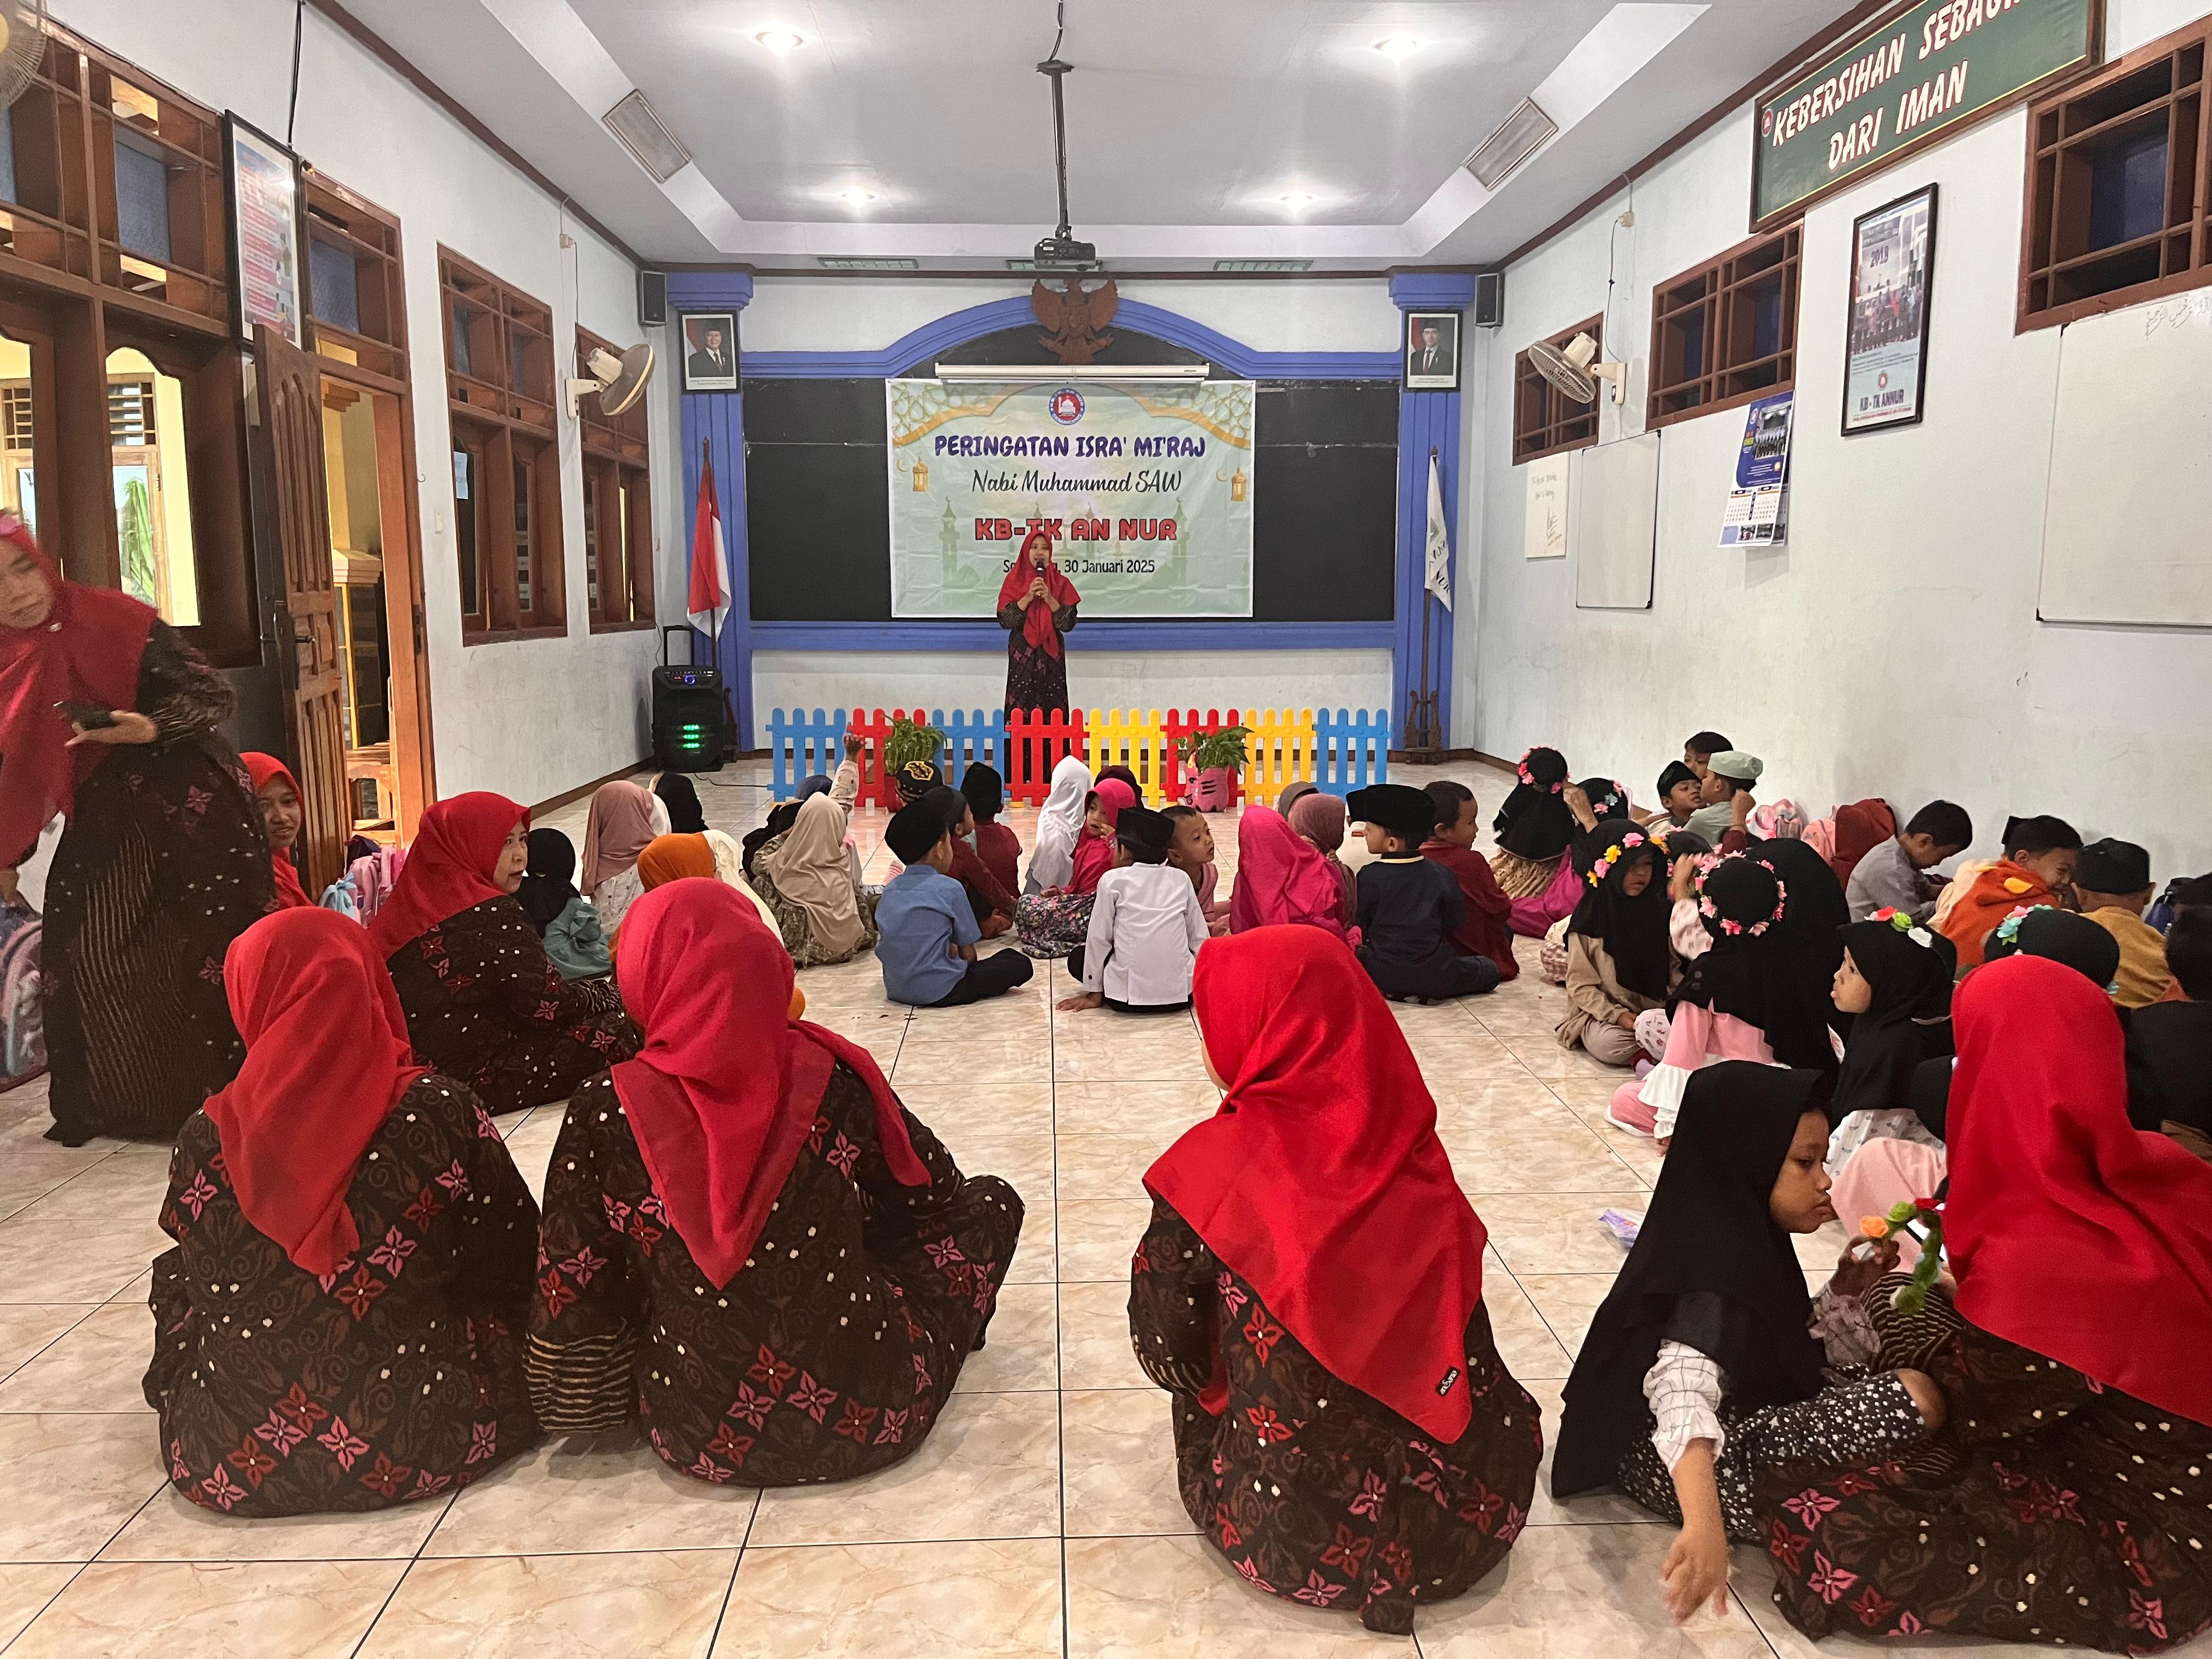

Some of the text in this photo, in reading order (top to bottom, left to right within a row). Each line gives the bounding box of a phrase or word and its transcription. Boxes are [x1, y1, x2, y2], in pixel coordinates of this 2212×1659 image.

[1773, 0, 2020, 147] KEBERSIHAN SEBAG
[1829, 60, 1968, 171] DARI IMAN
[935, 435, 1205, 458] PERINGATAN ISRA' MI'RAJ
[972, 469, 1181, 493] Nabi Muhammad SAW
[975, 518, 1177, 541] KB-TK AN NUR
[1064, 560, 1079, 573] 30
[1082, 559, 1123, 573] Januari
[1126, 560, 1155, 573] 2025
